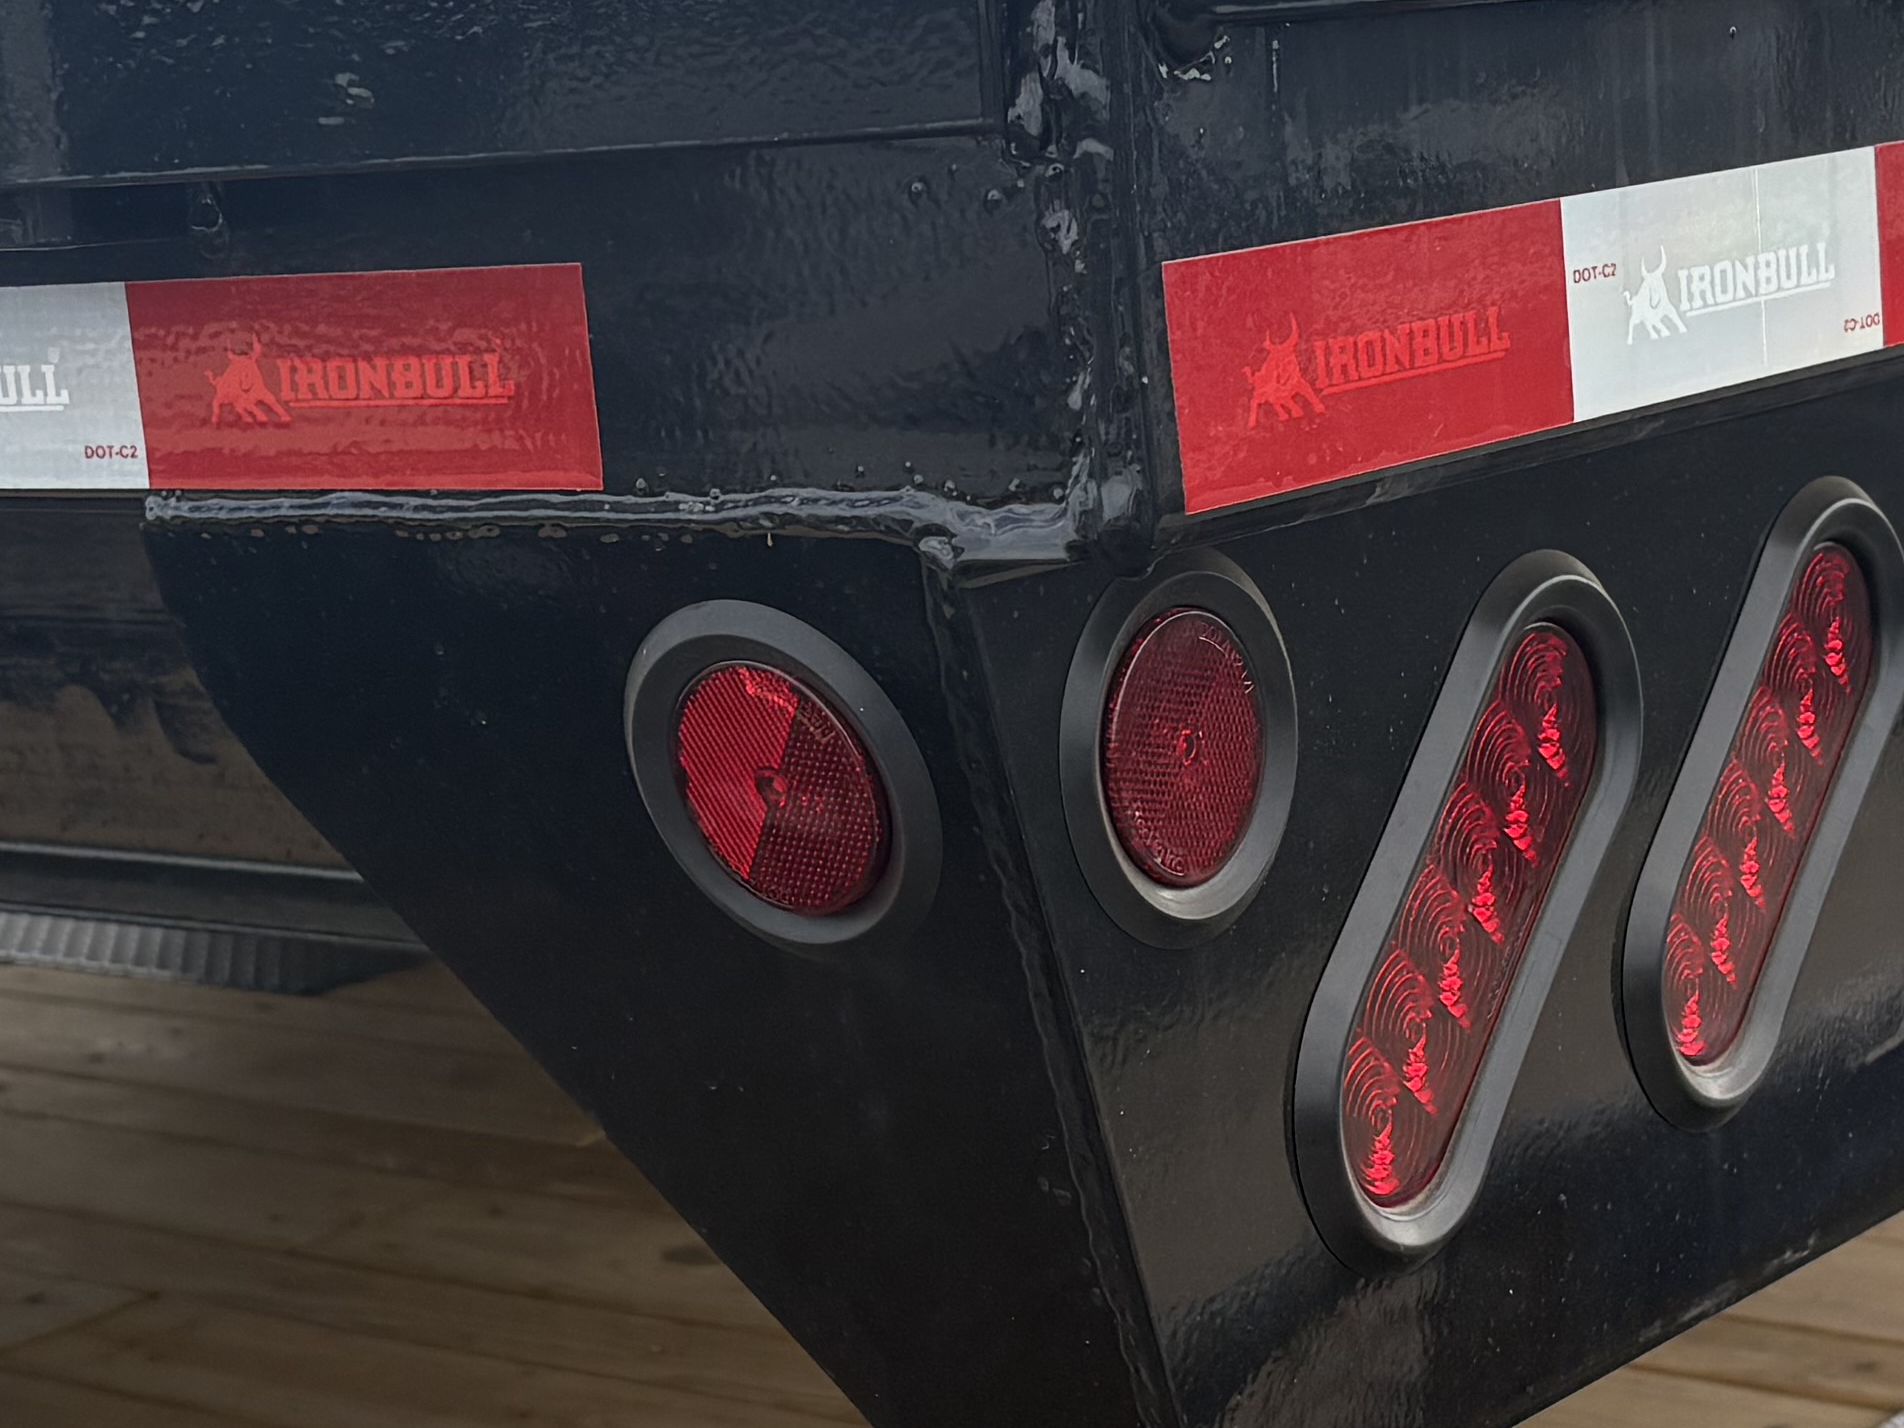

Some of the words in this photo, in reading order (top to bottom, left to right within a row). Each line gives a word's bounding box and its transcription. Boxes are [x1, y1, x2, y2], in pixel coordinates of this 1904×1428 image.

[1572, 262, 1618, 284] DOT-C2
[1676, 240, 1836, 313] IRONBULL
[1310, 305, 1511, 388] IRONBULL
[275, 350, 515, 401] IRONBULL
[84, 445, 139, 460] DOT-C2
